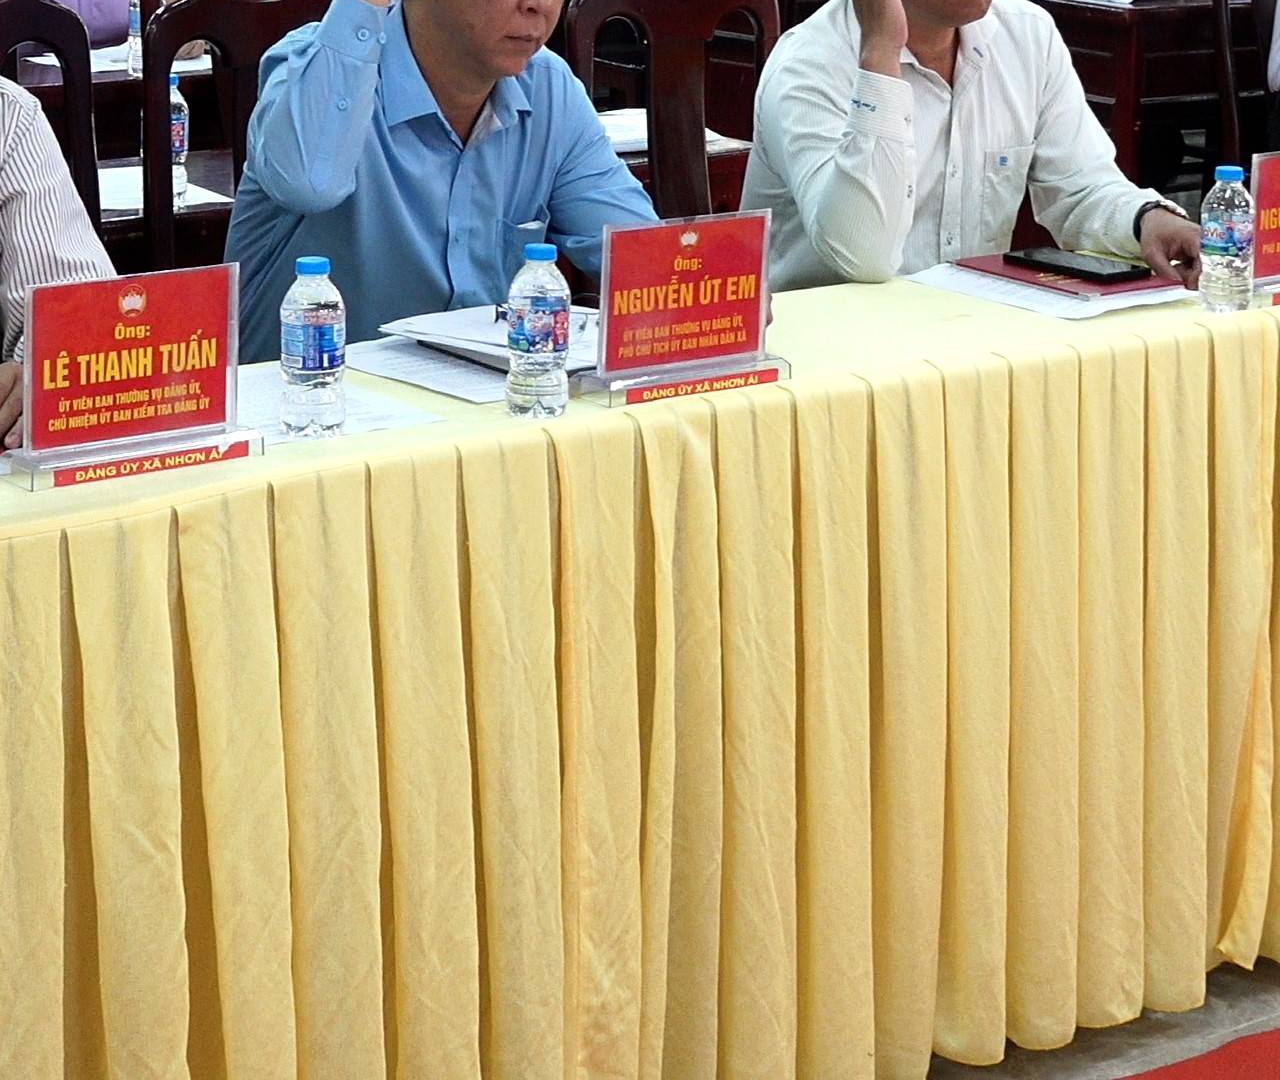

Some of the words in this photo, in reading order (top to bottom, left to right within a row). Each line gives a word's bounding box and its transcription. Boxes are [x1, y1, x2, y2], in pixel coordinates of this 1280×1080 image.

[674, 256, 702, 271] Ông:
[614, 275, 694, 316] NGUYỄN
[699, 275, 721, 305] ÚT
[726, 274, 756, 301] EM
[114, 322, 151, 340] Ông:
[42, 351, 70, 390] LÊ
[77, 346, 152, 386] THANH
[160, 330, 217, 374] TUẤN
[59, 397, 71, 412] ỦY
[72, 395, 93, 411] VIÊN
[95, 395, 114, 408] BAN
[116, 388, 150, 404] THƯỜNG
[151, 388, 162, 401] VỤ
[164, 382, 187, 398] ĐẢNG
[643, 386, 675, 400] ĐẢNG
[678, 383, 693, 395] ỦY
[695, 380, 710, 392] XÃ
[713, 377, 745, 390] NHƠN
[747, 374, 759, 385] ÁI
[48, 414, 66, 431] CHỦ
[69, 411, 98, 430] NHIỆM
[100, 408, 112, 424] ỦY
[114, 408, 132, 422] BAN
[134, 404, 156, 420] KIỂM
[157, 403, 172, 416] TRA
[174, 398, 198, 413] ĐẢNG
[199, 394, 210, 410] ỦY
[75, 466, 117, 482] ĐẢNG
[121, 462, 140, 474] ỦY
[142, 457, 163, 470] XÃ
[166, 451, 206, 467] NHƠN
